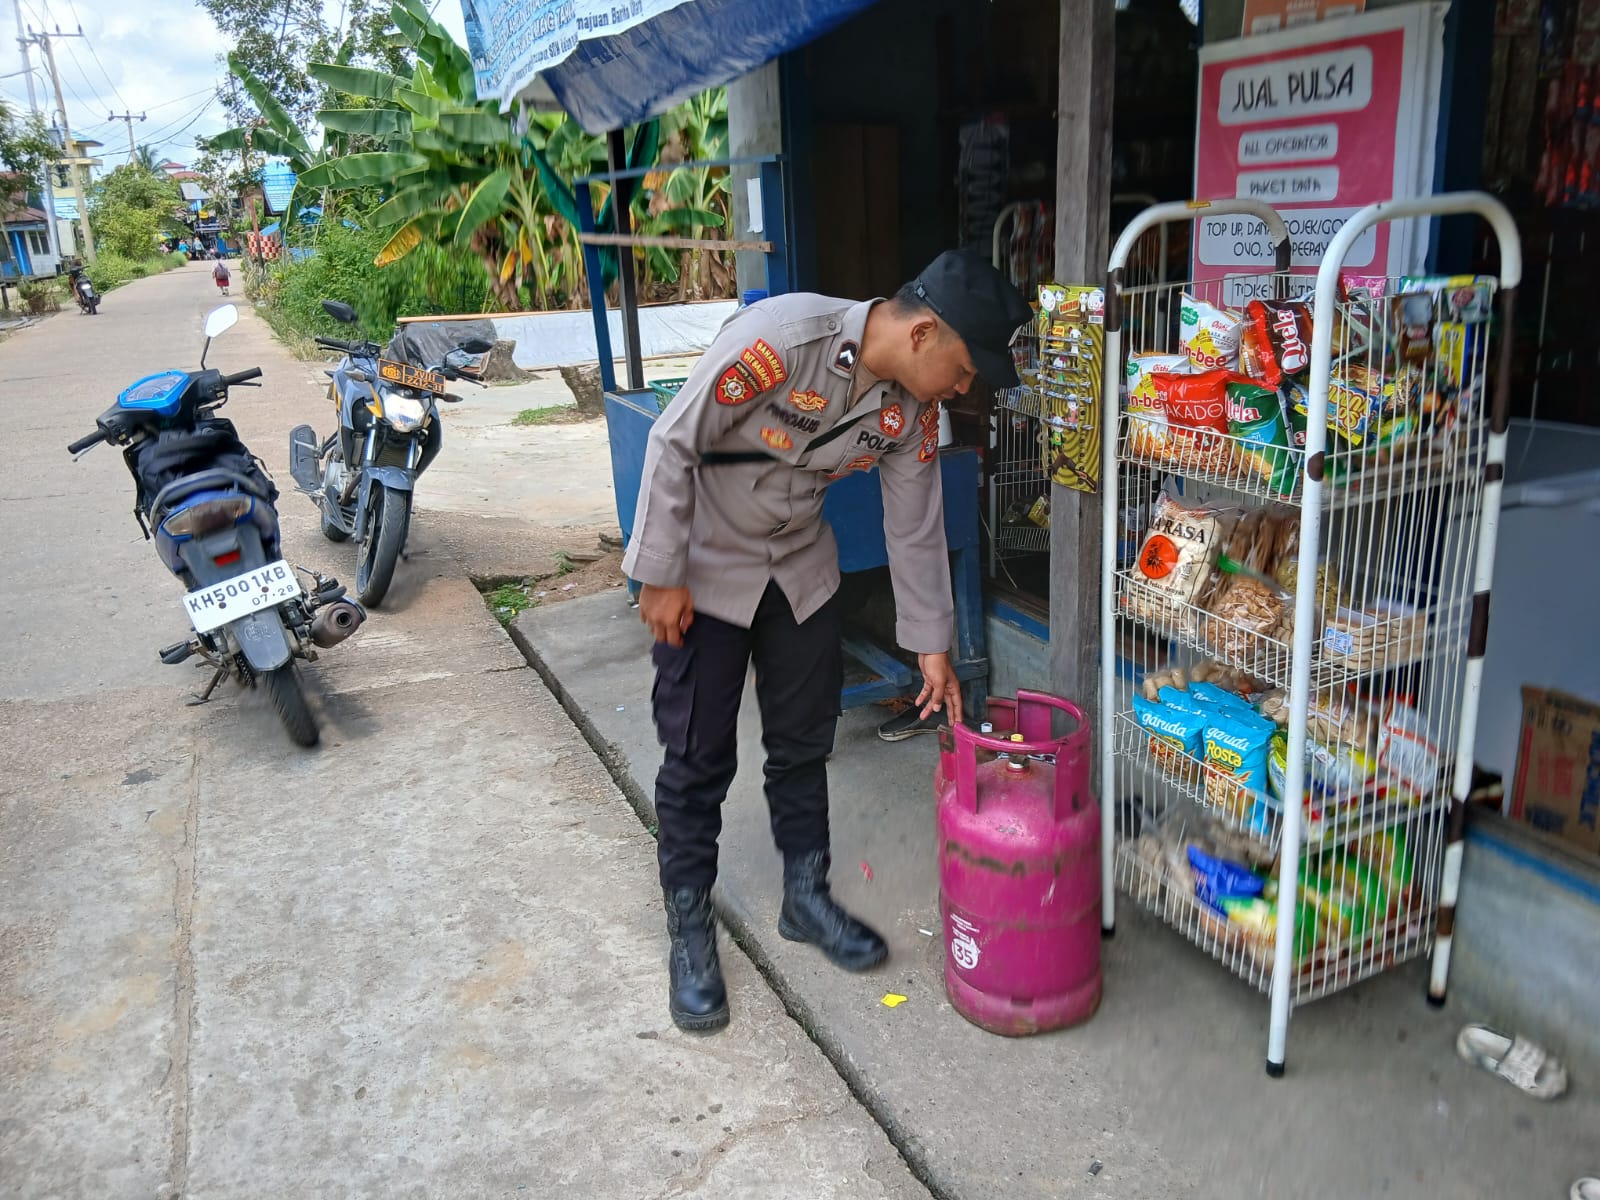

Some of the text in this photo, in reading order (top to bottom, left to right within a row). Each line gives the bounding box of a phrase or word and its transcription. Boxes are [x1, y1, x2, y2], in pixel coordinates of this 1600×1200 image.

[1232, 63, 1355, 113] JUAL PULSA
[1264, 134, 1329, 156] OPERATOR
[1250, 175, 1322, 196] PAKET DATA
[1206, 222, 1227, 237] TOP
[1231, 222, 1244, 238] UP,
[1233, 241, 1264, 258] OVO,
[1234, 283, 1274, 298] TOKE
[1273, 309, 1308, 375] Qtela
[1163, 519, 1205, 544] RASA
[1142, 712, 1188, 738] garuda
[1206, 727, 1250, 751] garuda
[1206, 739, 1243, 767] Rosta
